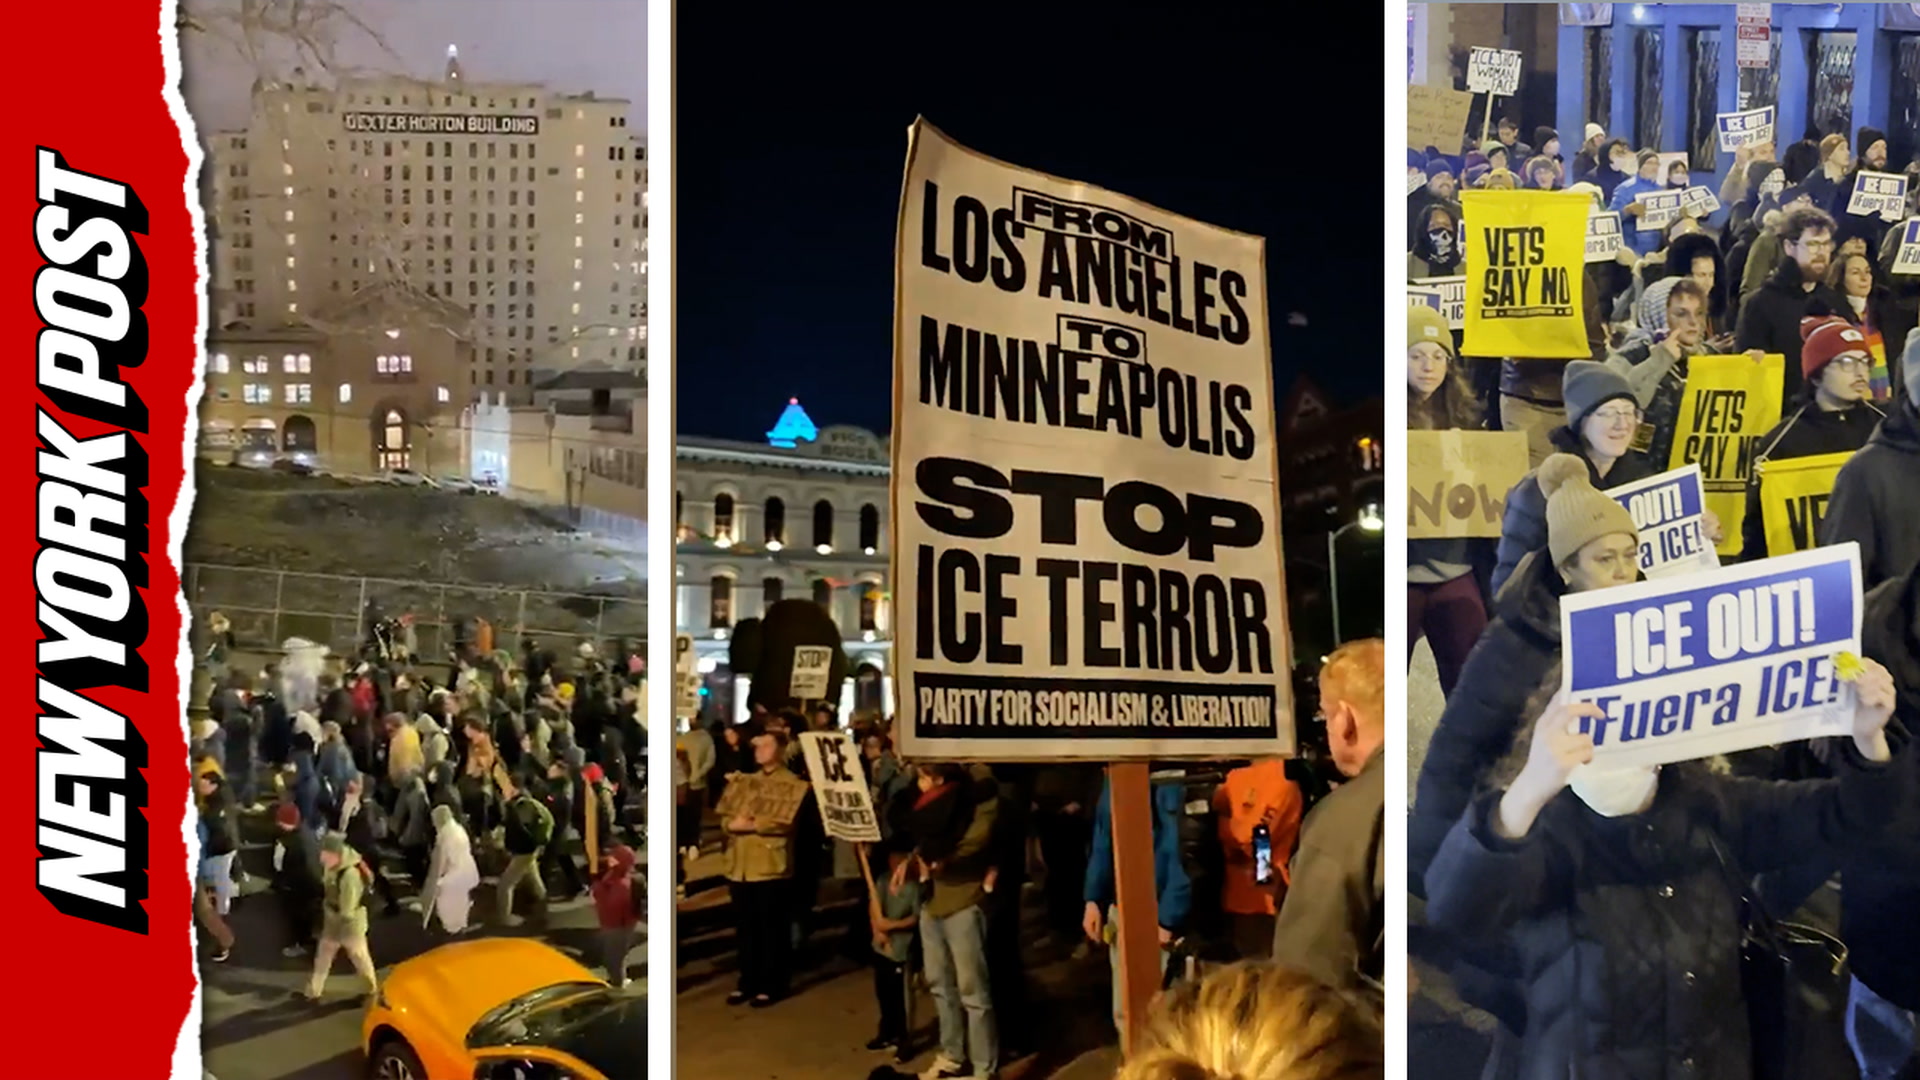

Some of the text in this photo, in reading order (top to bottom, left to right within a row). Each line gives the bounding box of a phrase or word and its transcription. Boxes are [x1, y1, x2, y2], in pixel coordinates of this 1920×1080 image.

[1472, 49, 1496, 66] ICE
[1477, 65, 1514, 79] WOMAN
[1491, 78, 1516, 93] FACE
[346, 114, 536, 133] DEXTER HORTON BUILDING
[1021, 193, 1167, 257] FROM
[1483, 226, 1545, 267] VETS
[922, 179, 1251, 346] LOS ANGELES
[1482, 266, 1571, 307] SAY NO
[1066, 319, 1141, 359] TO
[919, 314, 1256, 460] MINNEAPOLIS
[1692, 389, 1747, 434] VETS
[1684, 435, 1729, 479] SAY
[915, 456, 1264, 562] STOP
[1407, 481, 1504, 528] NOW
[1629, 482, 1684, 530] OUT!
[1785, 492, 1832, 551] VE
[1659, 520, 1704, 564] ICE!
[916, 543, 1274, 674] ICE TERROR
[1614, 577, 1816, 680] ICE OUT!
[797, 650, 829, 668] STOP
[920, 686, 1271, 728] PARTY FOR SOCIALISM & LIBERATION
[1756, 653, 1840, 718] ICE!
[815, 735, 854, 783] ICE
